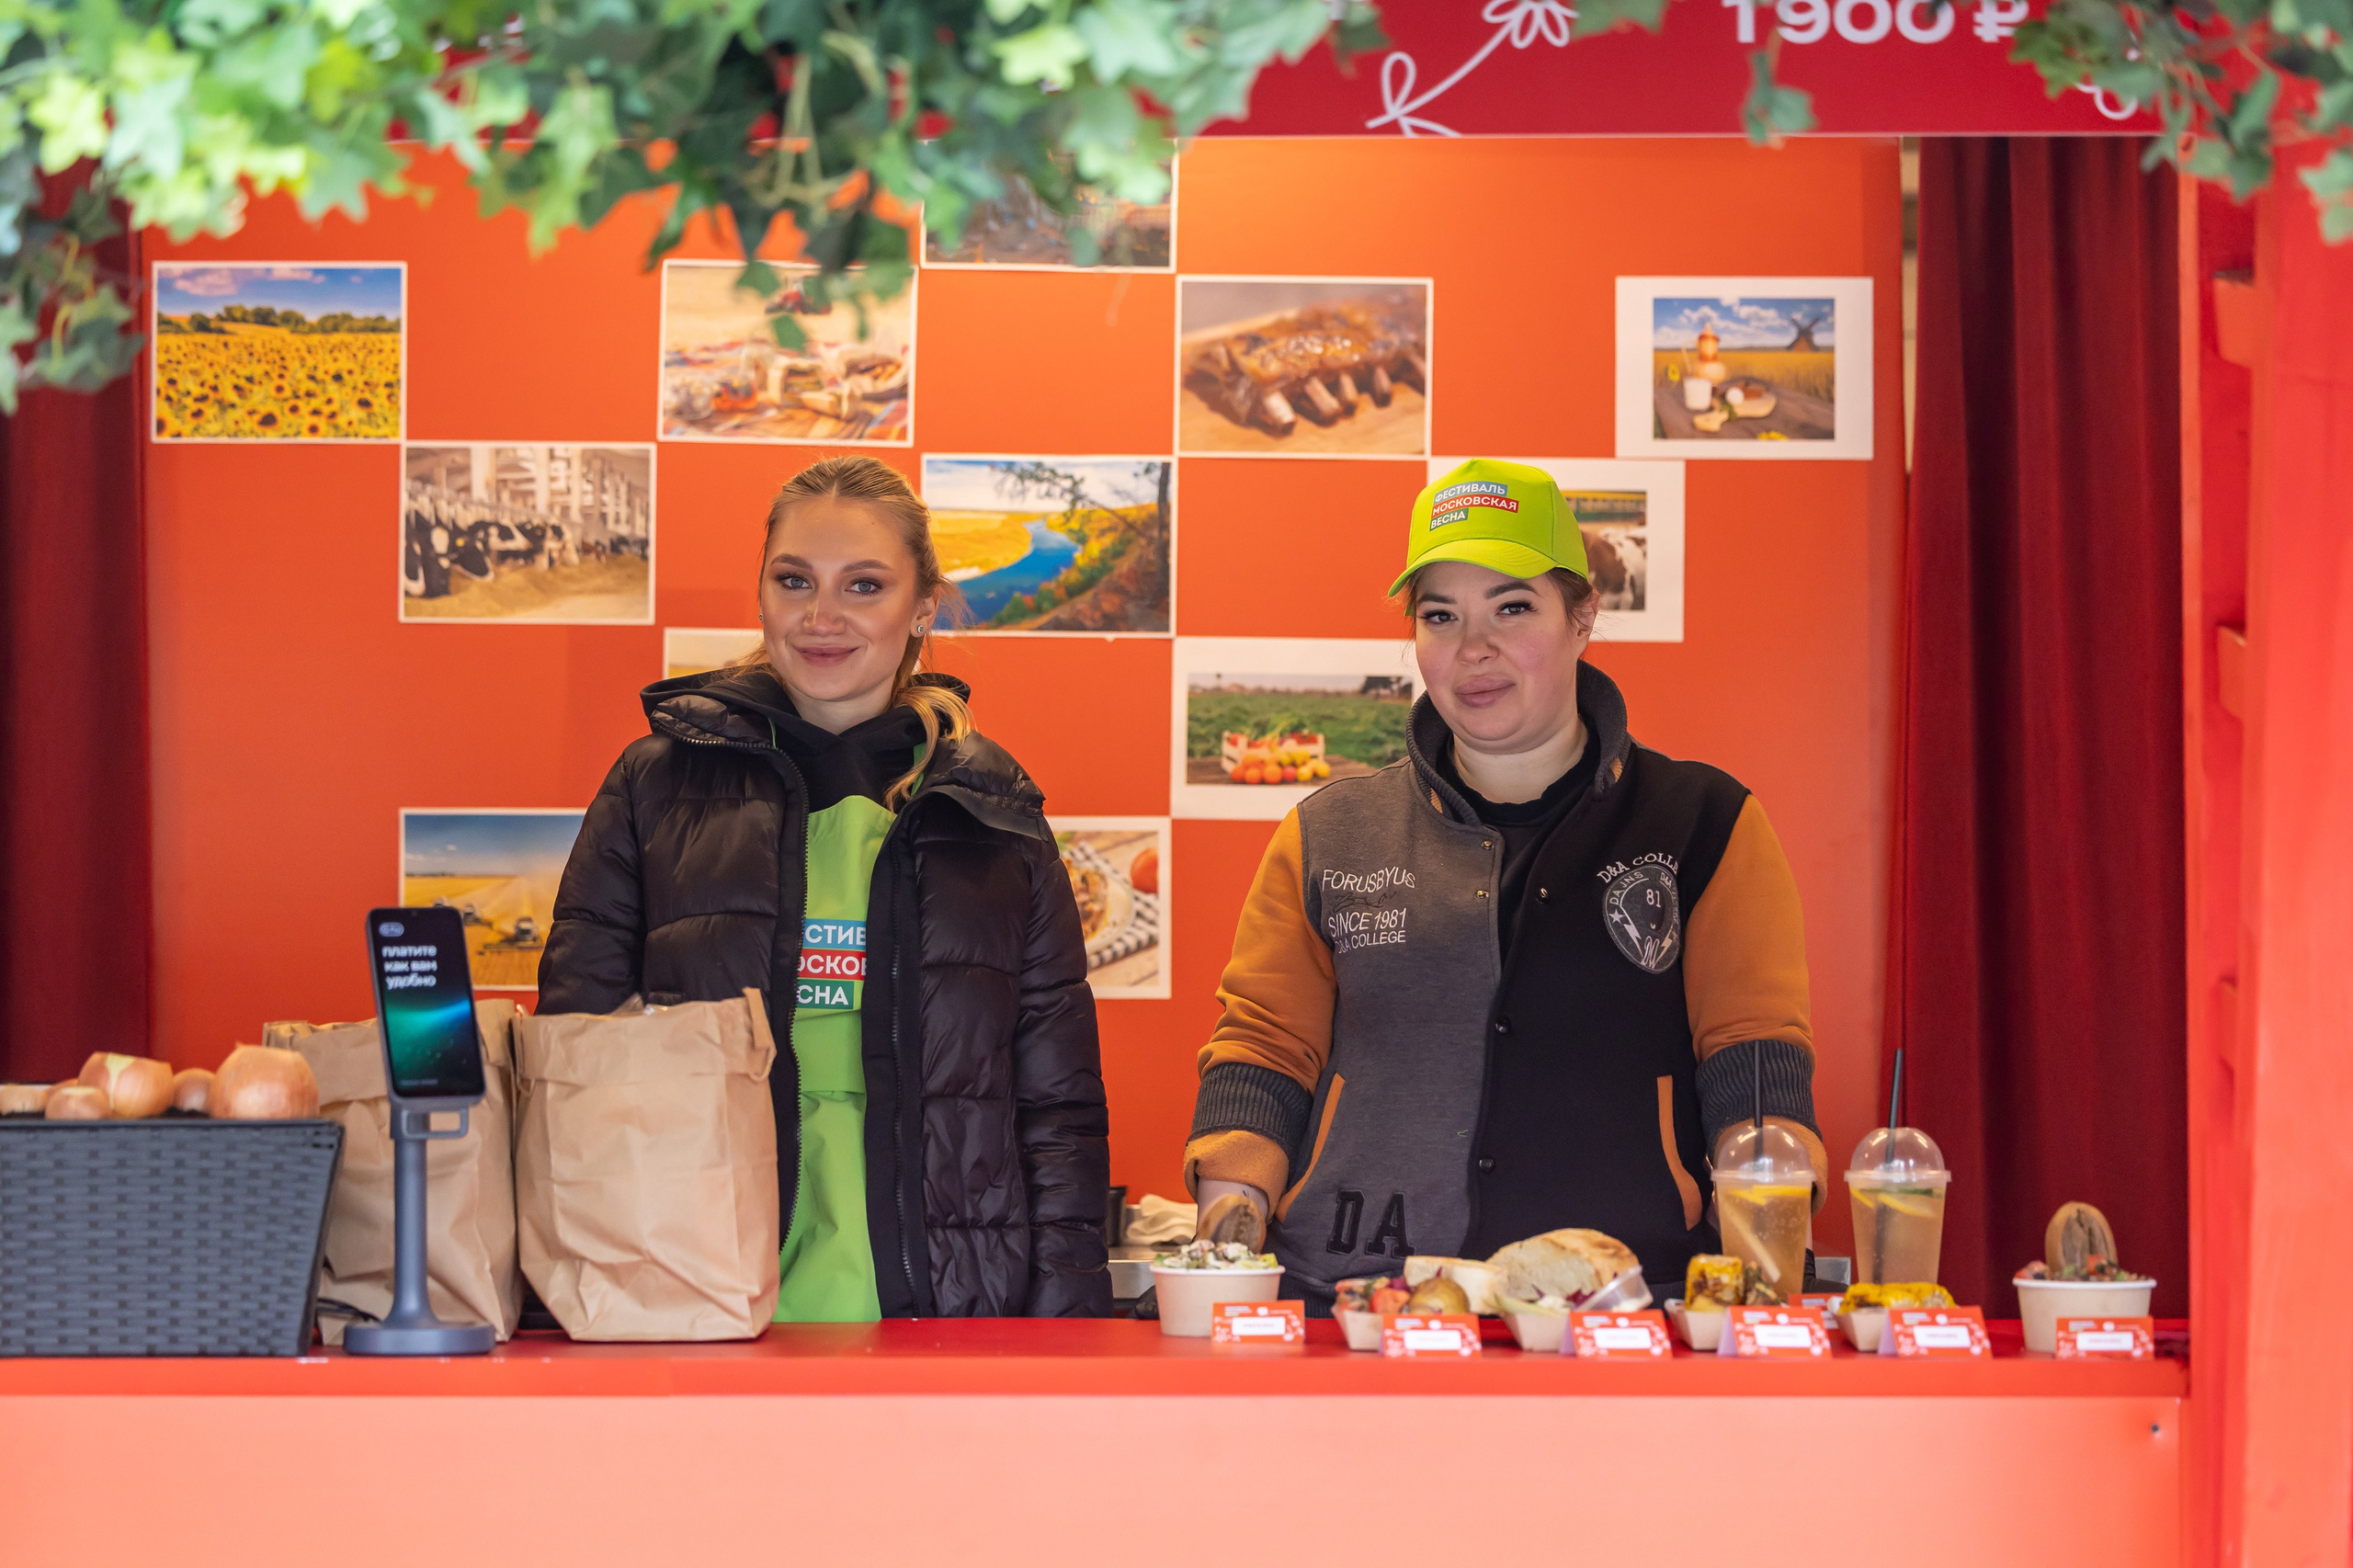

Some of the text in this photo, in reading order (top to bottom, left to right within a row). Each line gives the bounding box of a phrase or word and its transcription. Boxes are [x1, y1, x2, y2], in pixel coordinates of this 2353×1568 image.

[1435, 483, 1506, 503] ФЕСТИВАЛЬ
[1432, 496, 1518, 517] МОСКОВСКАЯ
[1430, 511, 1466, 530] ВЕСНА
[1322, 866, 1415, 892] FORUSBYUS
[1597, 861, 1631, 883] D&A
[1646, 888, 1662, 908] 81
[1328, 907, 1406, 937] SINCE 1981
[1351, 930, 1406, 949] COLLEGE
[381, 945, 438, 958] платите
[383, 960, 438, 972] как вам
[385, 972, 437, 990] удобно
